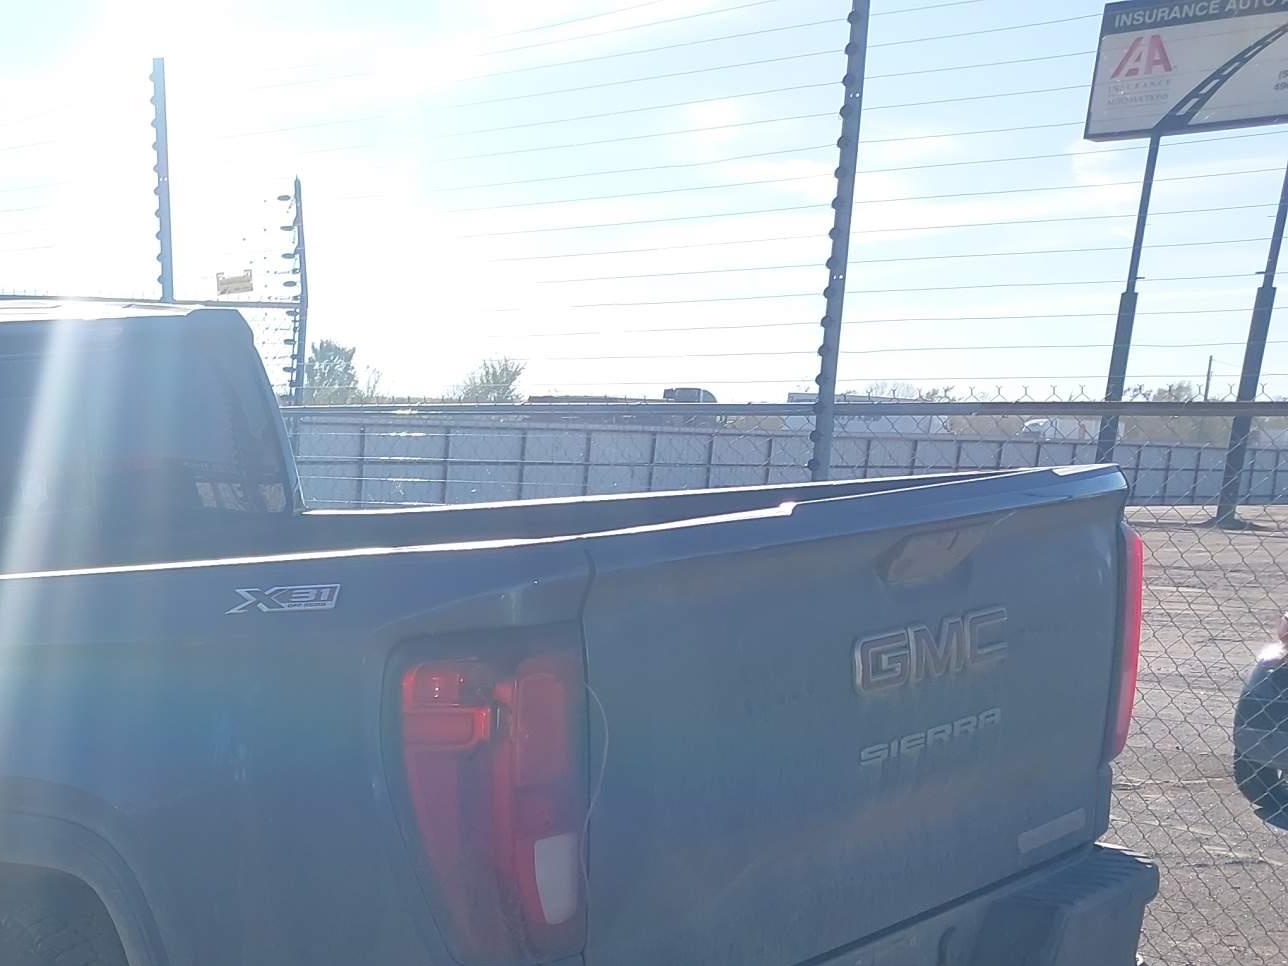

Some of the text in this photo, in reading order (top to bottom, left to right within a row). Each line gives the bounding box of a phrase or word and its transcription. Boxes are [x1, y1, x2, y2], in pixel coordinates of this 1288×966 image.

[1114, 0, 1220, 28] INSURANCE
[224, 583, 340, 615] X31
[853, 605, 1008, 692] GMC
[859, 707, 1001, 766] SIERRA
